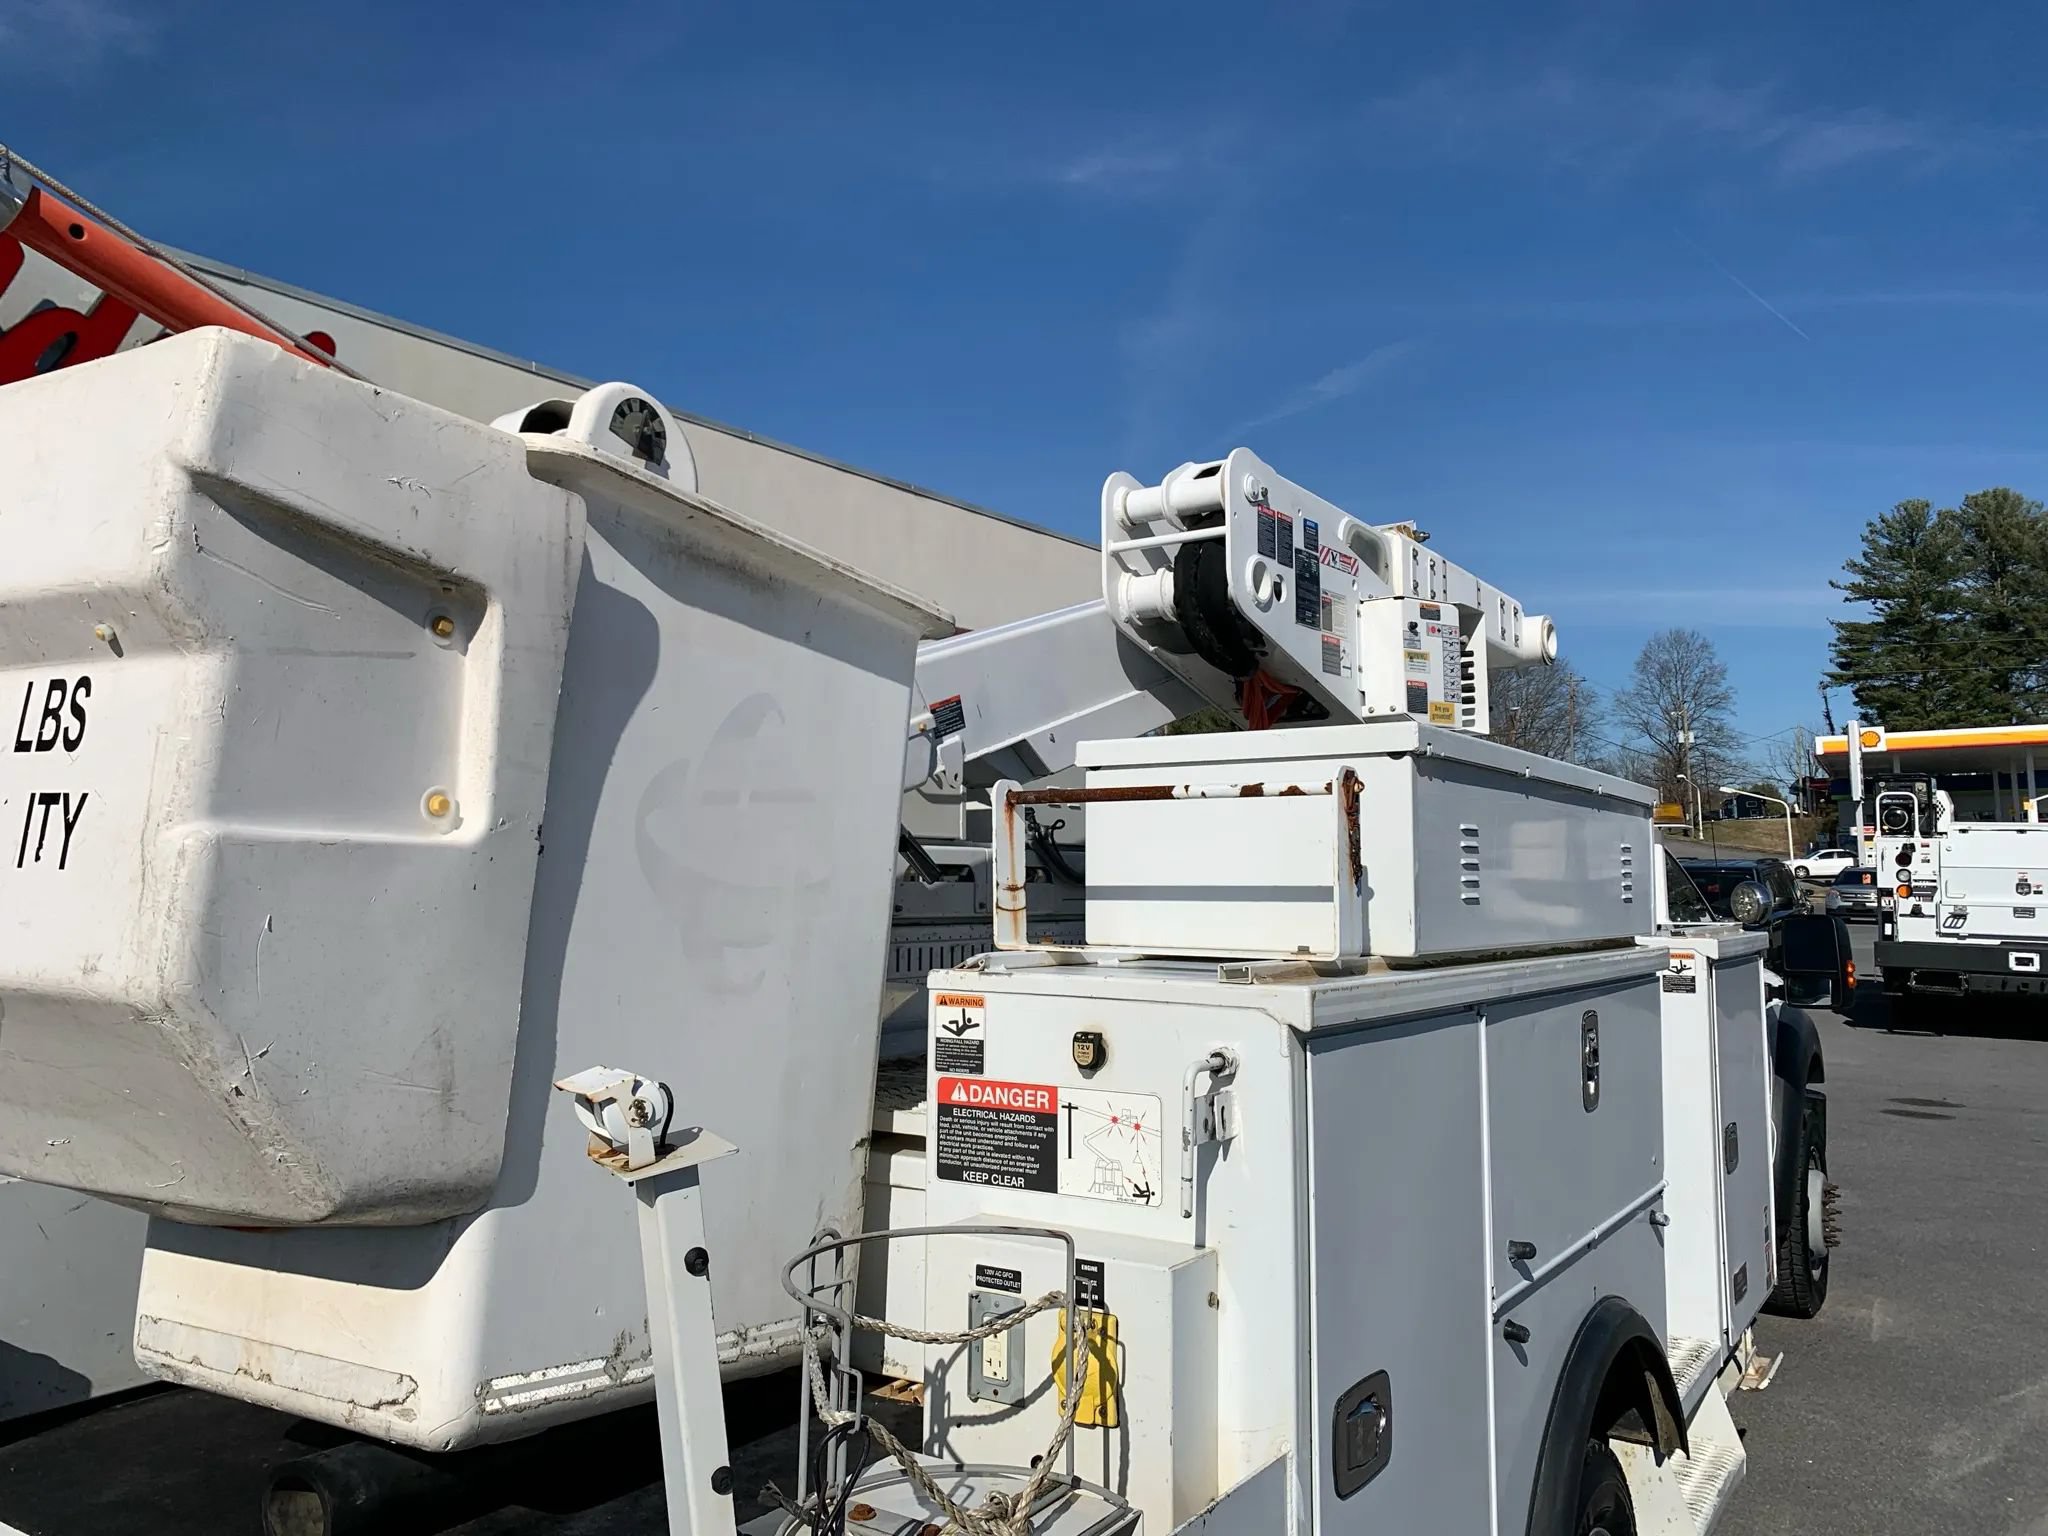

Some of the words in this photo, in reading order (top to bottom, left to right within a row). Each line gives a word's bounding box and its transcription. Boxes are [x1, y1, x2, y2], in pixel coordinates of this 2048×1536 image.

[14, 676, 92, 752] LBS
[948, 998, 984, 1007] WARNING
[970, 1085, 1050, 1109] DANGER
[953, 1108, 998, 1120] ELECTRICAL
[999, 1113, 1036, 1124] HAZARDS
[962, 1170, 989, 1183] KEEP
[991, 1173, 1025, 1188] CLEAR
[1081, 1264, 1098, 1272] ENGINE
[976, 1275, 1003, 1286] PROTECTED
[1003, 1280, 1021, 1288] OUTLET
[1080, 1292, 1099, 1300] HEAER
